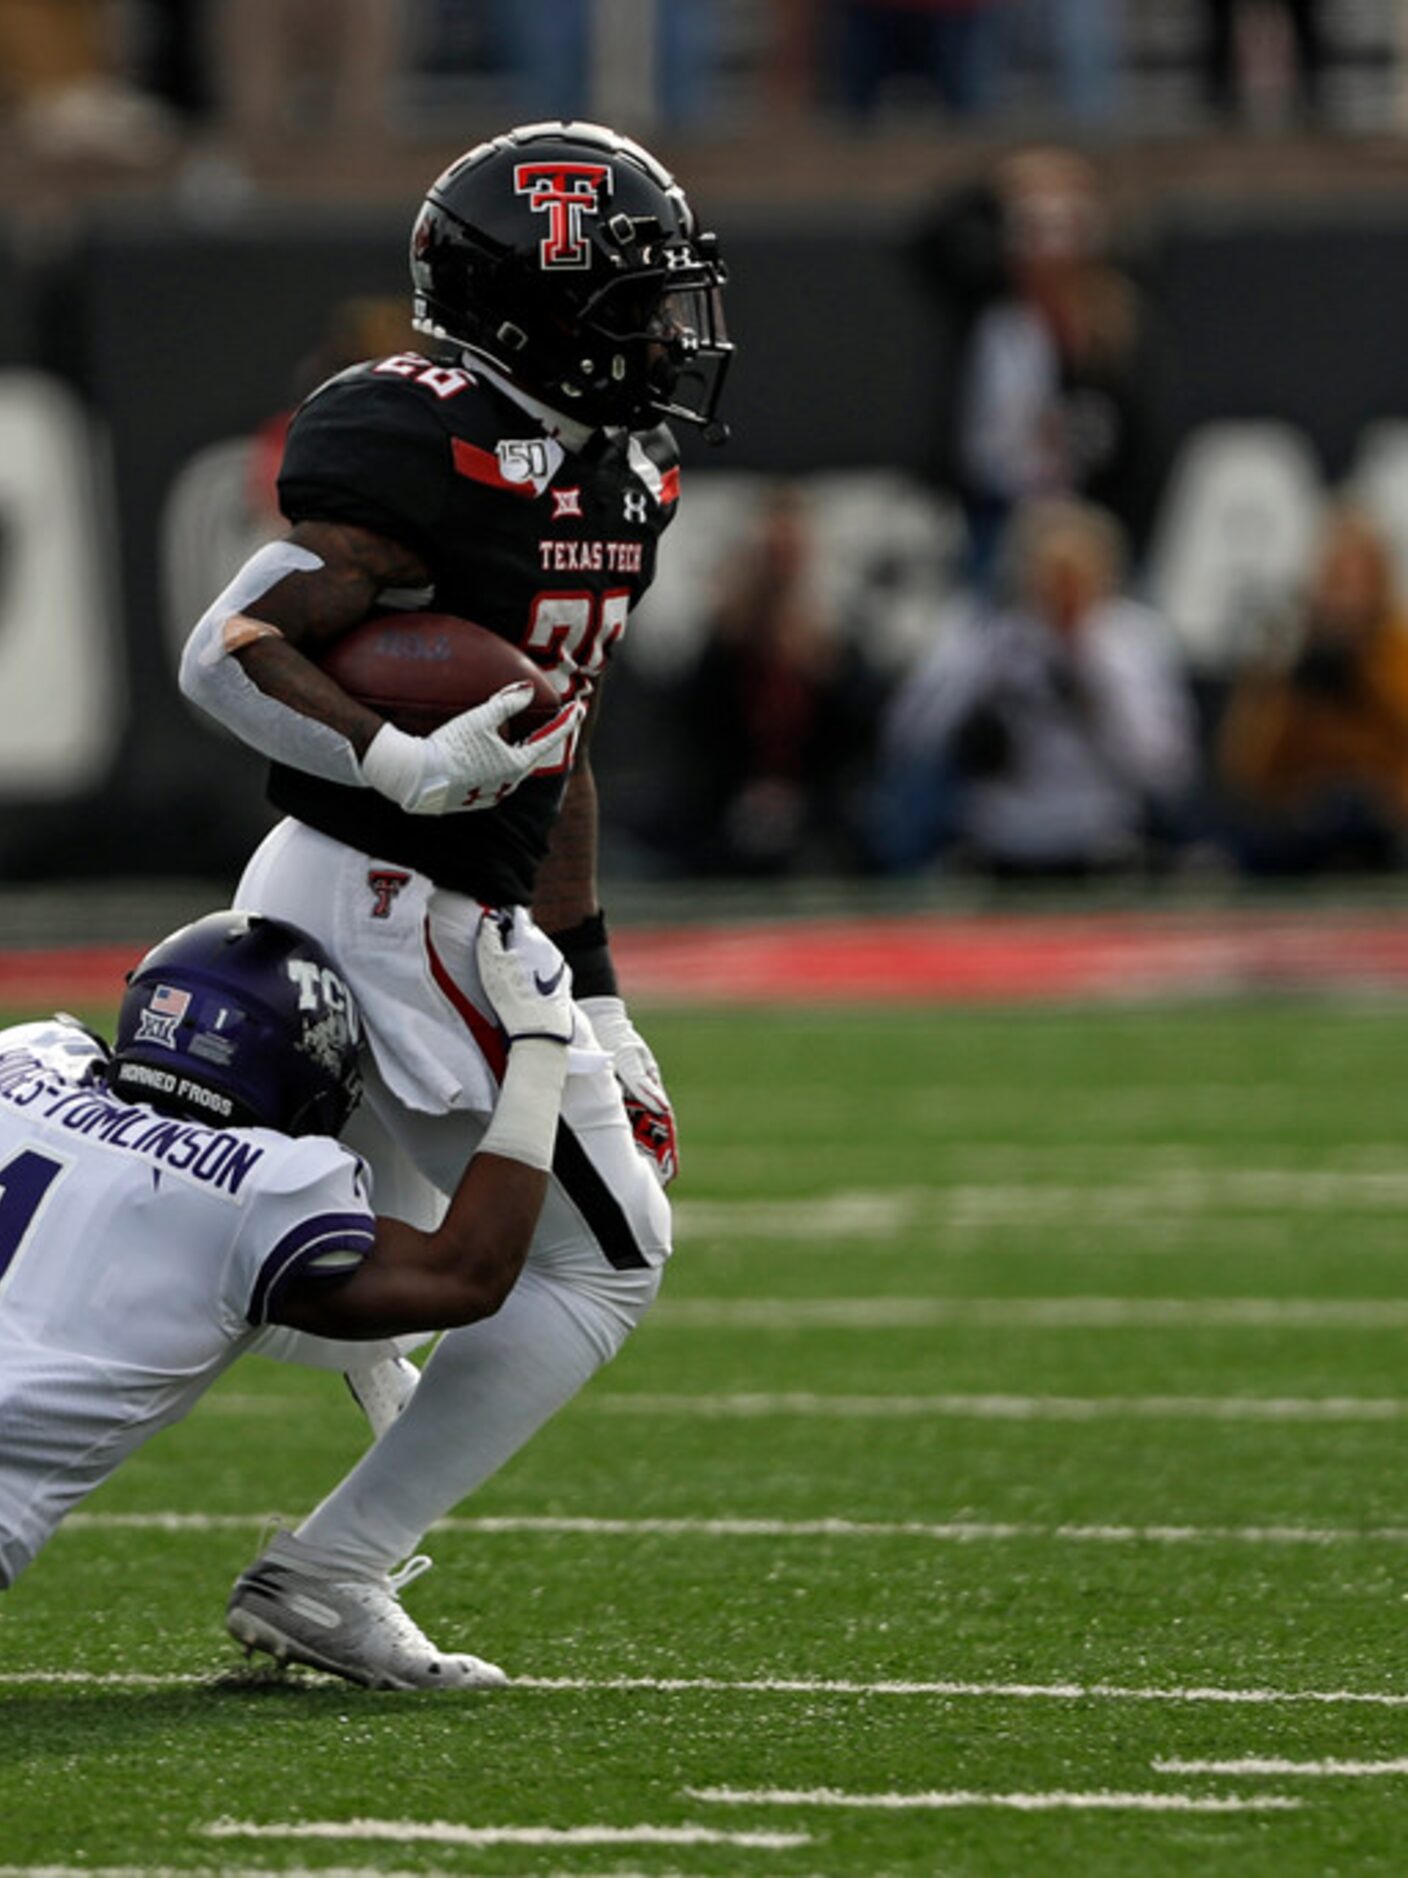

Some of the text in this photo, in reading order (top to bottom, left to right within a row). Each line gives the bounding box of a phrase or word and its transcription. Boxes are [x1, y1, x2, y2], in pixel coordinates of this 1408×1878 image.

[538, 538, 603, 572] TEXAS
[117, 1062, 234, 1117] HORNED FROGS
